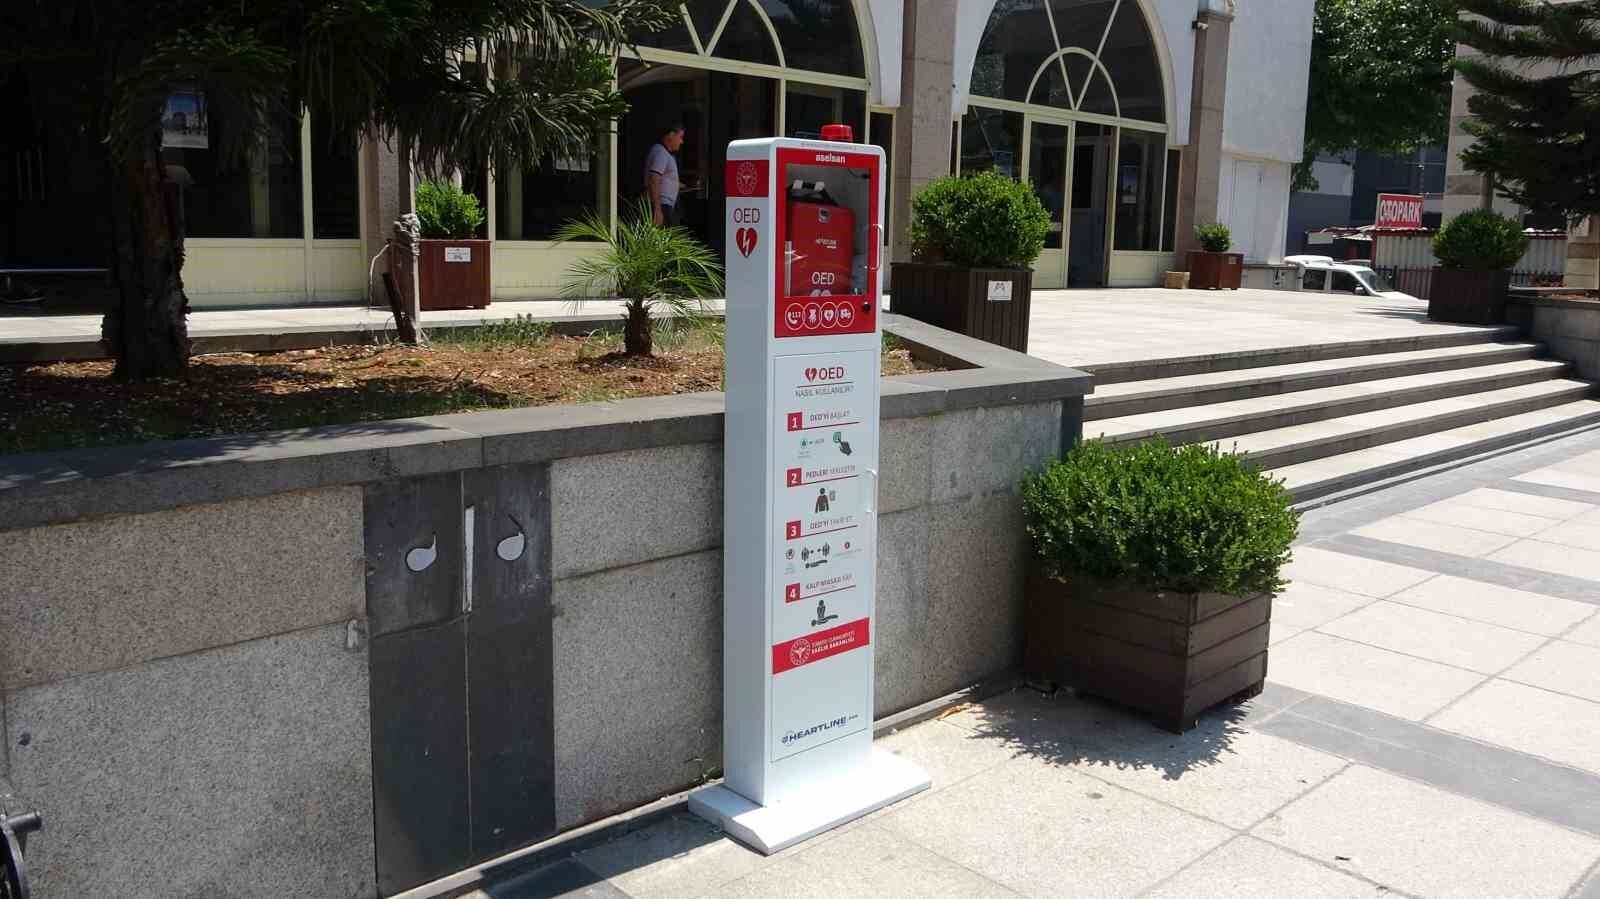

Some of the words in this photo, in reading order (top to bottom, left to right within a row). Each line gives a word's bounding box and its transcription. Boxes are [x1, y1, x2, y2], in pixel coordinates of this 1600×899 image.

[815, 152, 846, 164] aselsan
[734, 208, 760, 223] OED
[1380, 200, 1421, 223] OTOPARK
[812, 272, 835, 285] OED
[819, 366, 844, 380] OED
[792, 417, 798, 429] 1
[791, 473, 799, 484] 2
[790, 526, 797, 536] 3
[790, 588, 796, 598] 4
[789, 716, 846, 742] HEARTLINE
